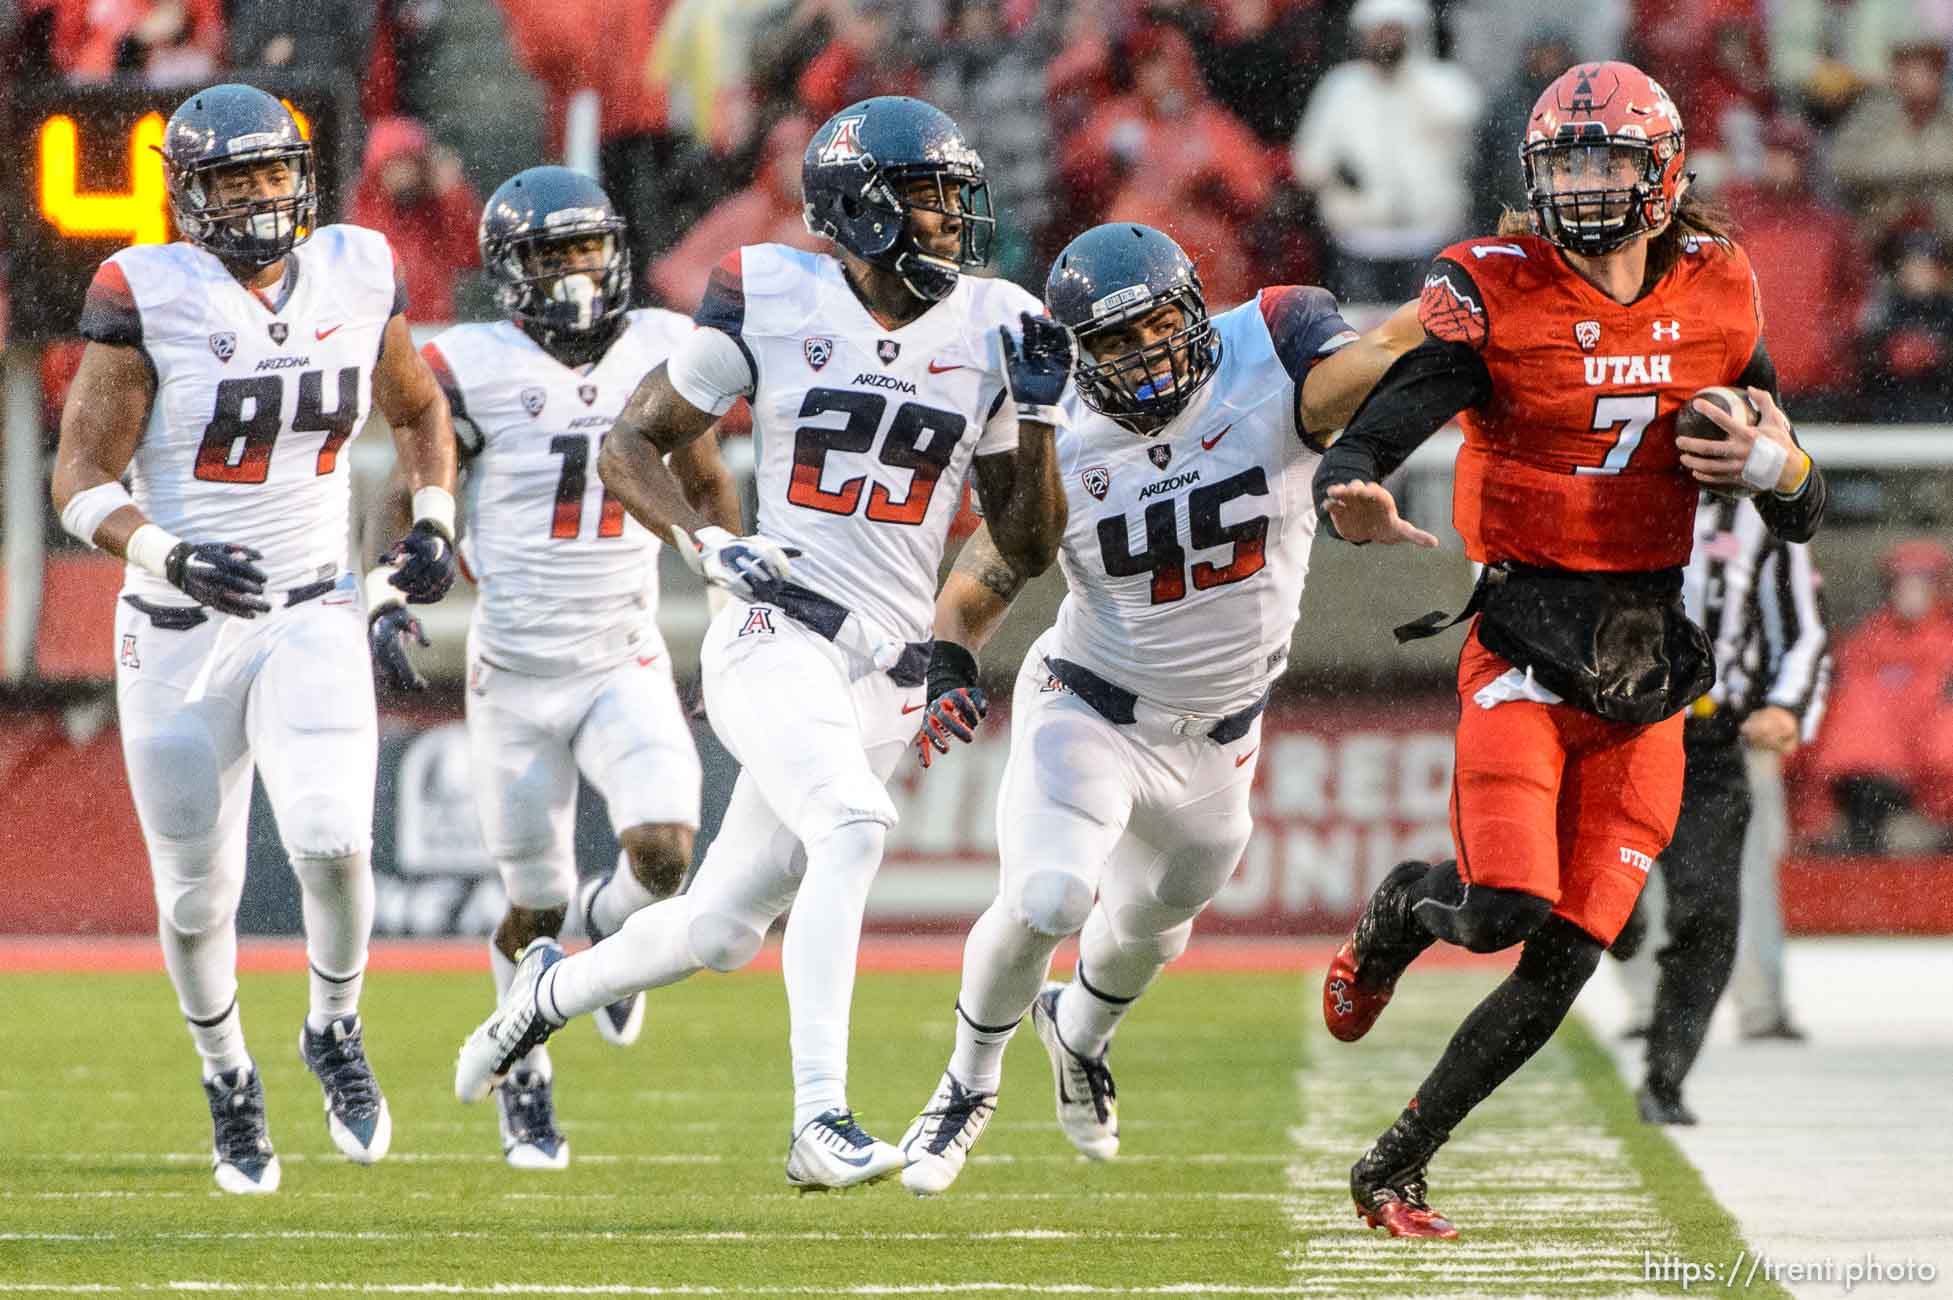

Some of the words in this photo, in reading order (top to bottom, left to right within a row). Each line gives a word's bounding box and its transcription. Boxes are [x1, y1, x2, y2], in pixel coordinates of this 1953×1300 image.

[254, 355, 310, 372] ARIZONA
[810, 351, 826, 365] 12
[1583, 355, 1672, 385] UTAH
[852, 372, 917, 396] ARIZONA
[194, 366, 360, 485] 84
[1572, 393, 1660, 477] 7
[787, 387, 968, 526] 29
[1091, 481, 1105, 495] 12
[1138, 470, 1201, 501] ARIZONA
[1097, 465, 1269, 606] 45
[738, 607, 776, 637] A
